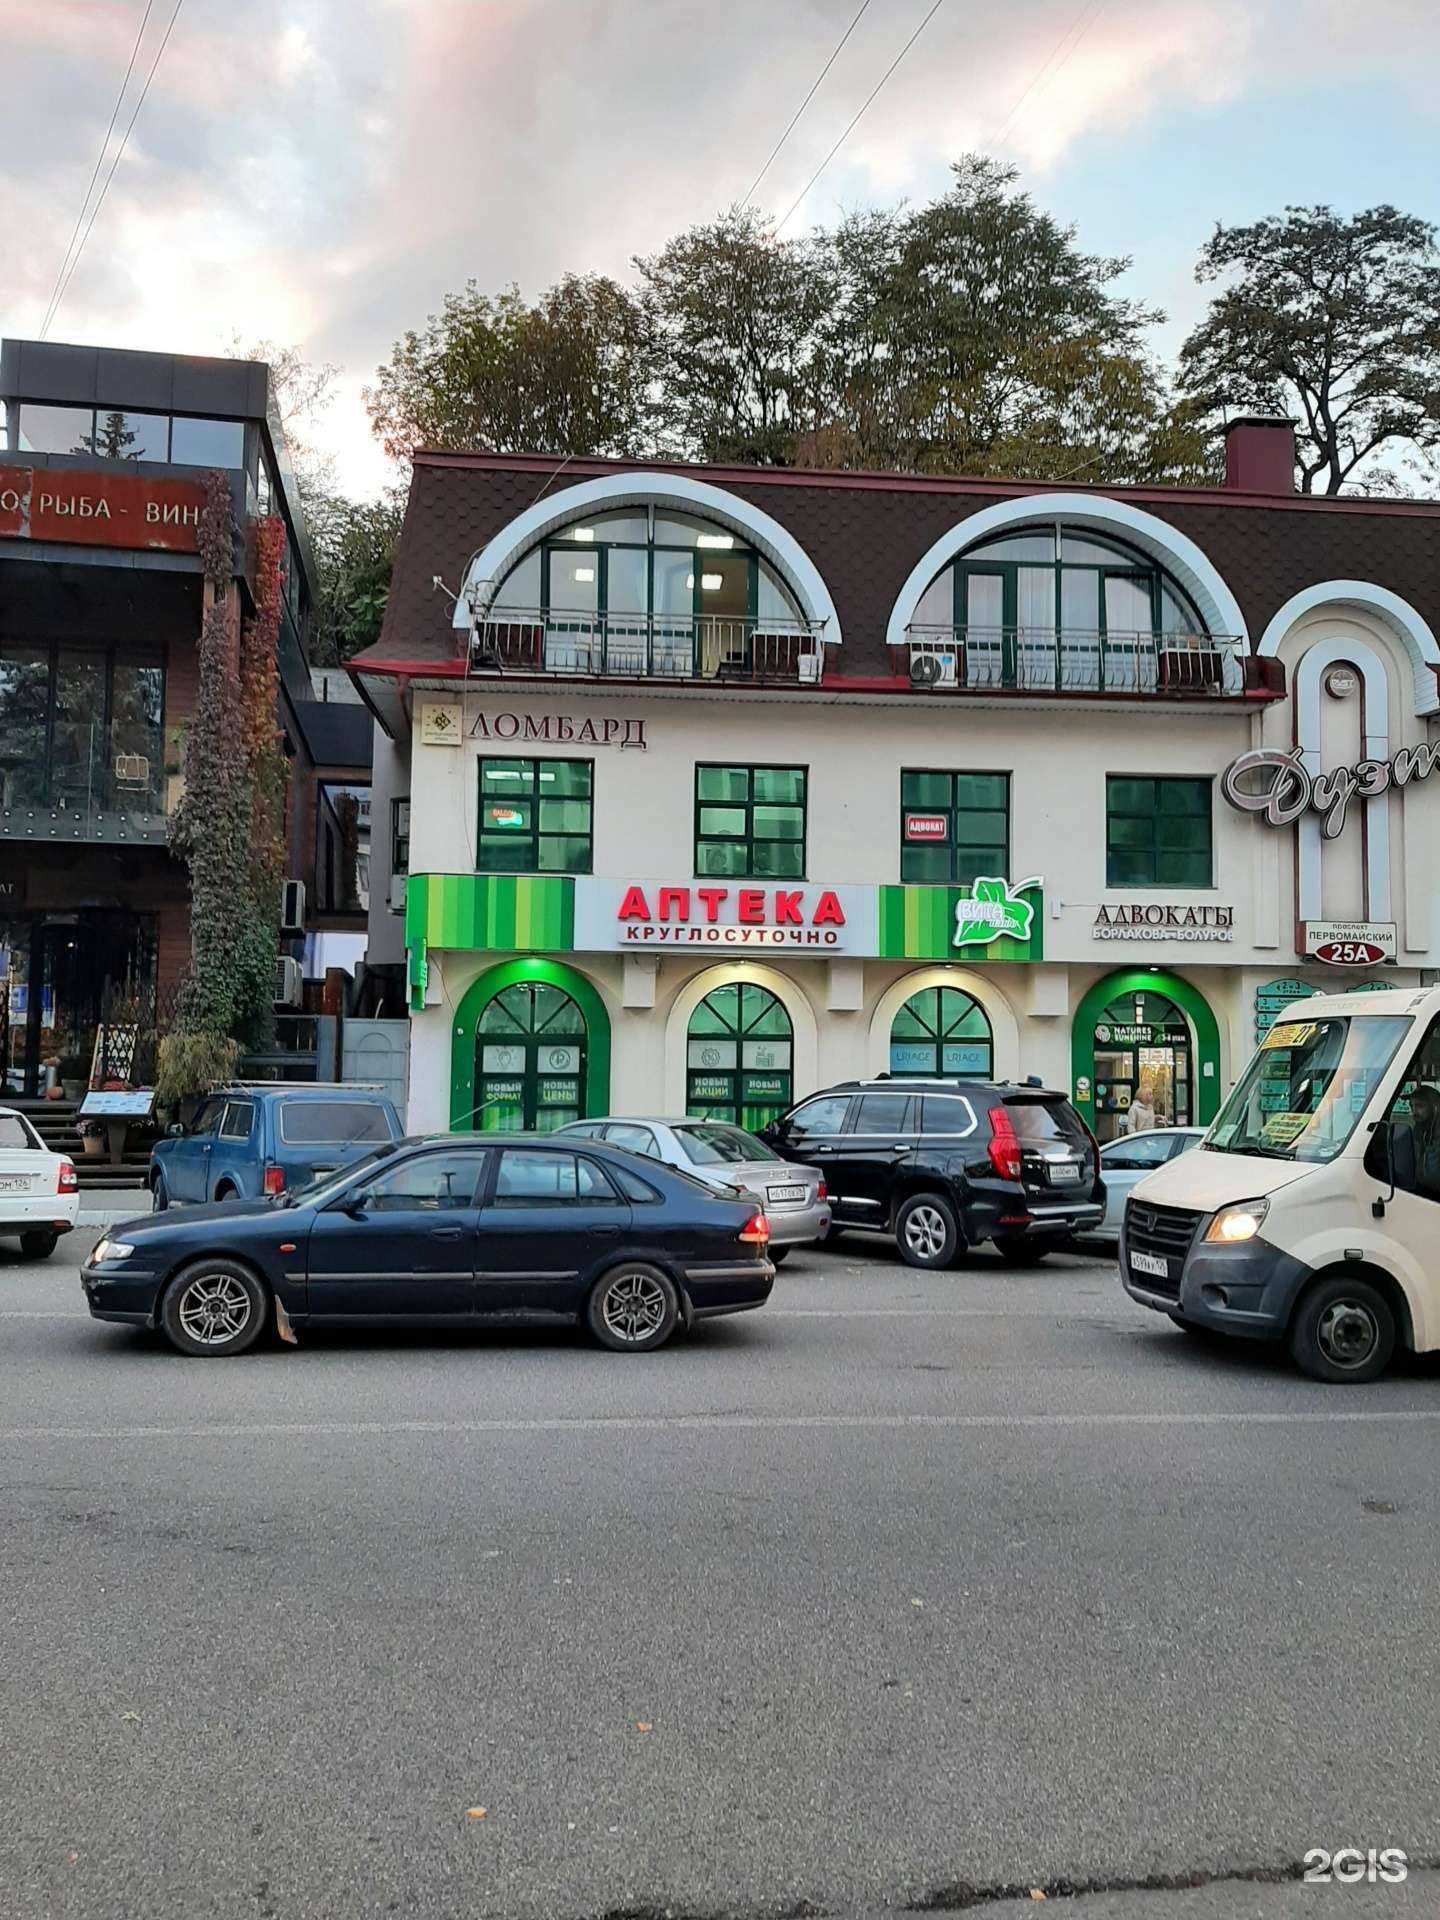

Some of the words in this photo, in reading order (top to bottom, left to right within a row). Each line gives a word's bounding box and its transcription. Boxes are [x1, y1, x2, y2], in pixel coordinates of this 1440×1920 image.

[39, 493, 111, 519] РЫБА
[469, 712, 647, 750] ЛОМБАРД
[910, 820, 944, 832] АДВОКАТ
[617, 886, 845, 925] АПТЕКА
[1095, 904, 1234, 928] АДВОКАТЫ
[627, 926, 838, 944] КРУГЛОСУТОЧНО
[1309, 931, 1393, 941] ПЕРВОМАЙСКИЙ
[1331, 944, 1370, 962] 25А
[1293, 1025, 1312, 1042] 27
[486, 1082, 522, 1091] НОВЫЙ
[543, 1081, 576, 1090] НОВЫЕ
[695, 1077, 729, 1087] НОВЫЕ
[749, 1080, 782, 1089] НОВЫЙ
[543, 1090, 576, 1101] ЦЕНЫ
[695, 1087, 729, 1097] АКЦИИ
